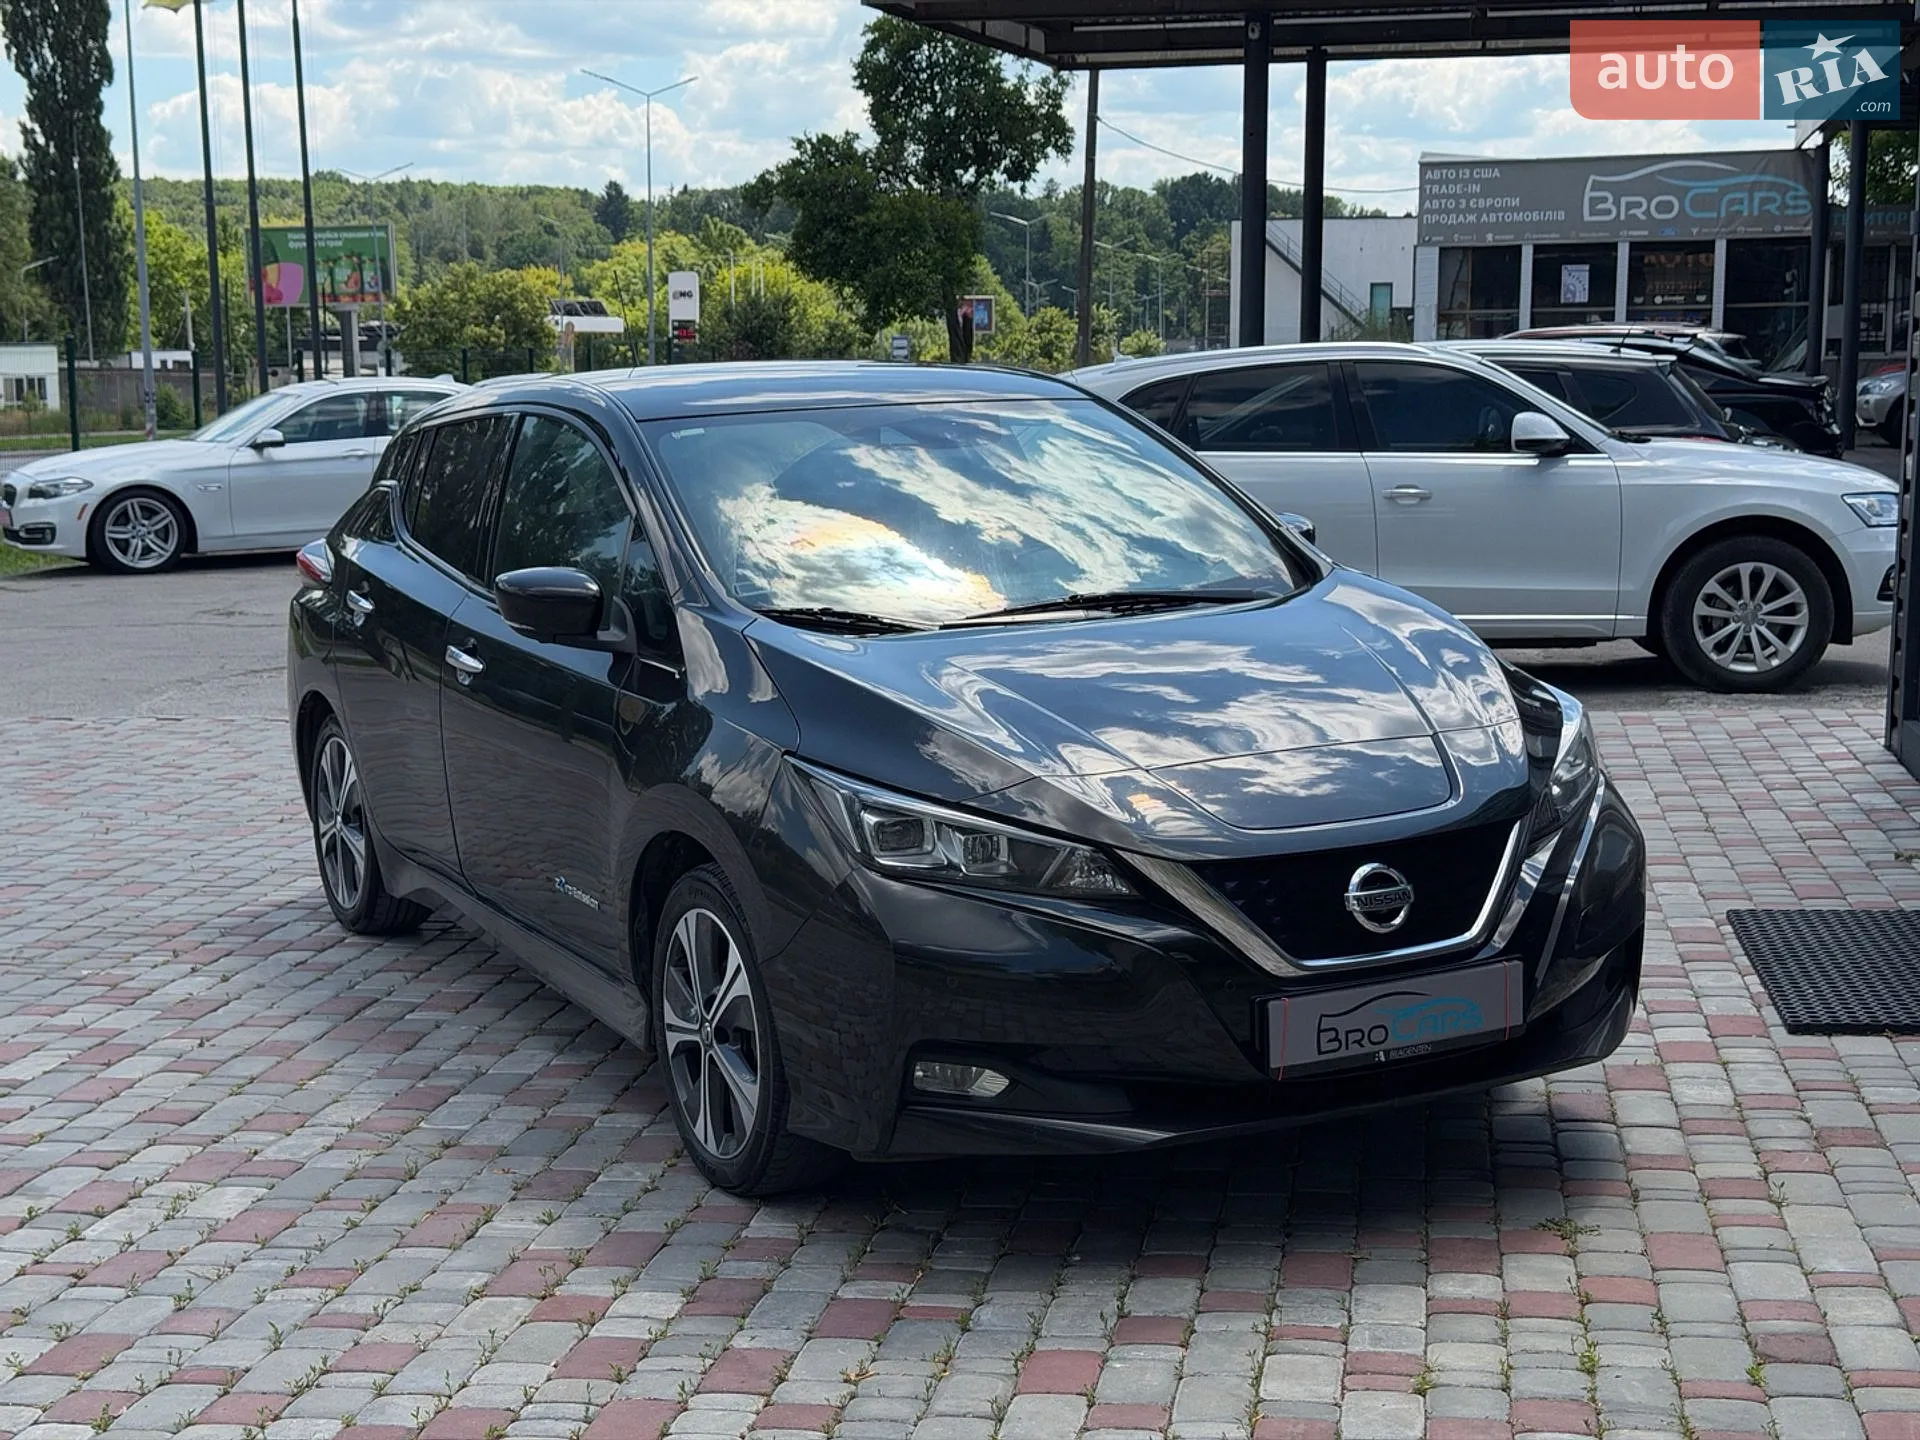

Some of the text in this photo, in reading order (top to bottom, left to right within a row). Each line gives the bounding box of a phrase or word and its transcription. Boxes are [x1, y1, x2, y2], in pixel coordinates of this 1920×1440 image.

[1425, 167, 1501, 180] АВТО ІЗ США
[1424, 183, 1481, 195] TRADE-IN
[1423, 199, 1456, 210] АВТО
[1469, 197, 1520, 209] ЄВРОПИ
[1423, 209, 1566, 226] ПРОДАЖ АВТОМОБІЛІВ
[1355, 889, 1411, 908] NISSAN
